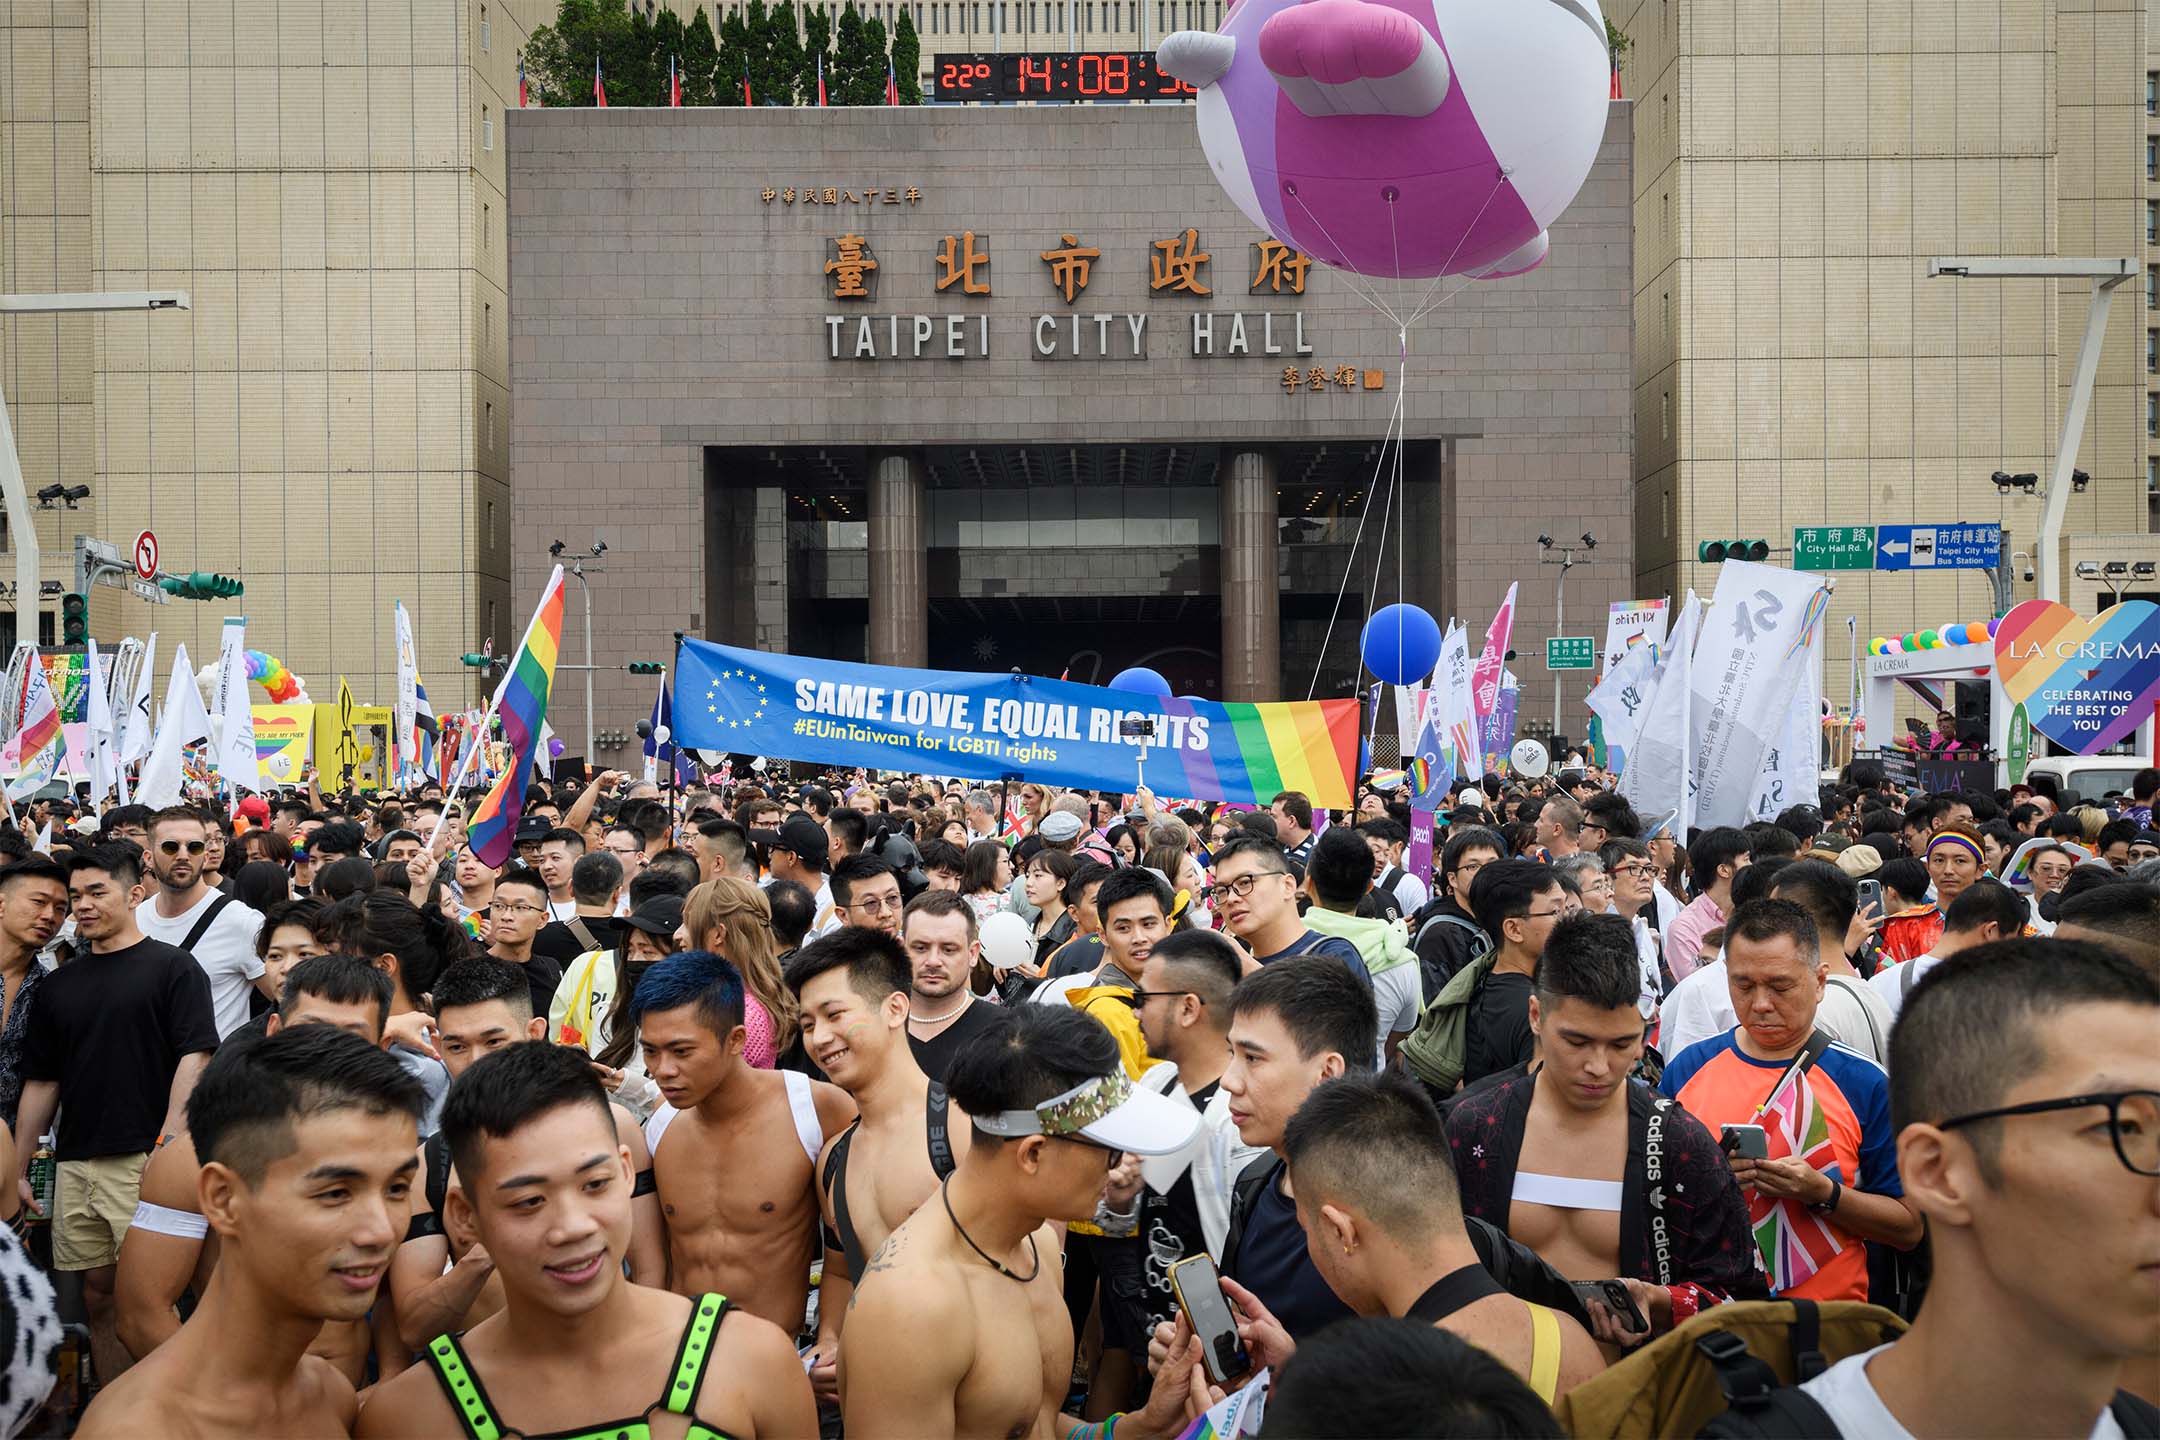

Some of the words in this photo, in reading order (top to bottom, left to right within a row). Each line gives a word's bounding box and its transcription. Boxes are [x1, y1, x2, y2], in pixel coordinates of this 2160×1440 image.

[760, 187, 924, 206] 中華民國八十三年
[824, 229, 1311, 305] 臺北市政府
[825, 314, 990, 358] TAIPEI
[1035, 312, 1148, 356] CITY
[1192, 310, 1314, 354] HALL
[1280, 364, 1357, 395] 李登輝
[1802, 528, 1867, 543] 市府路
[1806, 545, 1826, 554] City
[1829, 544, 1846, 553] Hall
[1847, 544, 1862, 552] Rd.
[1938, 547, 1961, 556] Taipei
[1964, 547, 1980, 556] City
[1983, 546, 1999, 554] Hall
[1937, 557, 1952, 565] Bus
[1956, 557, 1984, 565] Station
[2009, 641, 2046, 659] LA
[2056, 641, 2160, 660] CREMA
[1874, 661, 1883, 672] LA
[1884, 659, 1909, 671] CREMA
[2041, 690, 2133, 701] CELEBRATING
[795, 678, 885, 721] SAME
[890, 689, 975, 734] LOVE,
[982, 697, 1081, 741] EQUAL
[1088, 707, 1210, 751] RIGHTS
[2047, 705, 2072, 715] THE
[2076, 705, 2107, 716] BEST
[2110, 704, 2128, 716] OF
[2073, 719, 2100, 731] YOU
[793, 718, 911, 747] #EUinTaiwan
[916, 730, 943, 750] for
[948, 735, 1000, 756] LGBTI
[1005, 741, 1057, 764] rights
[1921, 768, 1962, 794] EMA
[1646, 1114, 1663, 1181] adidas
[1652, 1216, 1671, 1286] adidas
